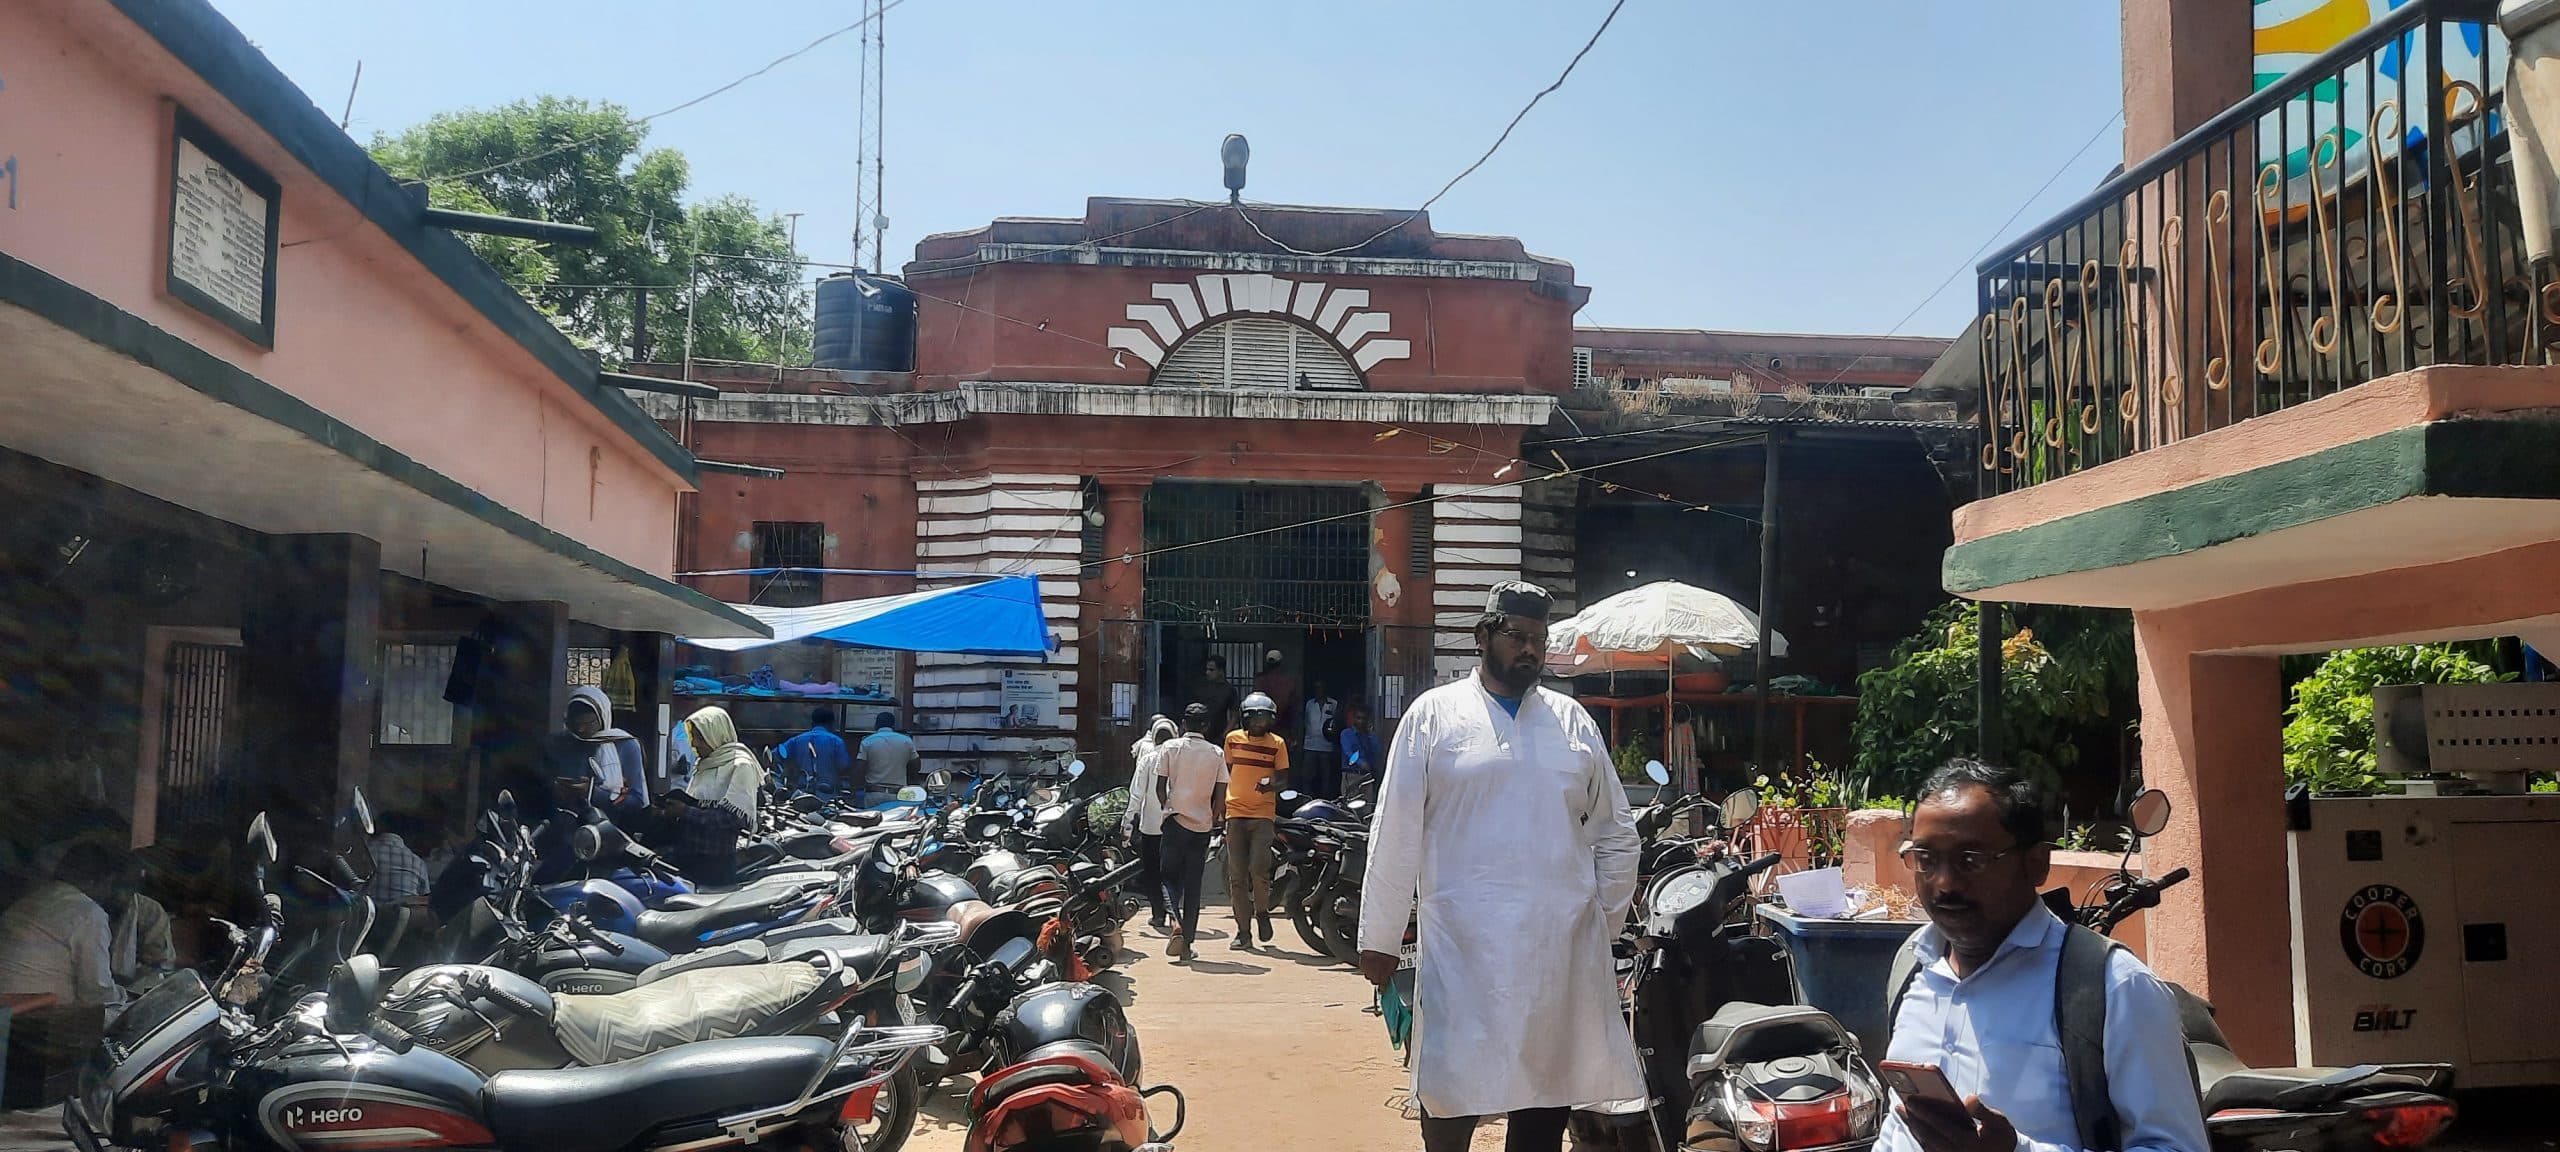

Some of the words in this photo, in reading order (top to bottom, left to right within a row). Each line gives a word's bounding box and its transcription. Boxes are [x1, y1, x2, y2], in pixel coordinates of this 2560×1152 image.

[2345, 887, 2418, 921] COOPER
[2360, 957, 2409, 977] CORP
[571, 984, 603, 993] Hero
[311, 1108, 363, 1124] Hero
